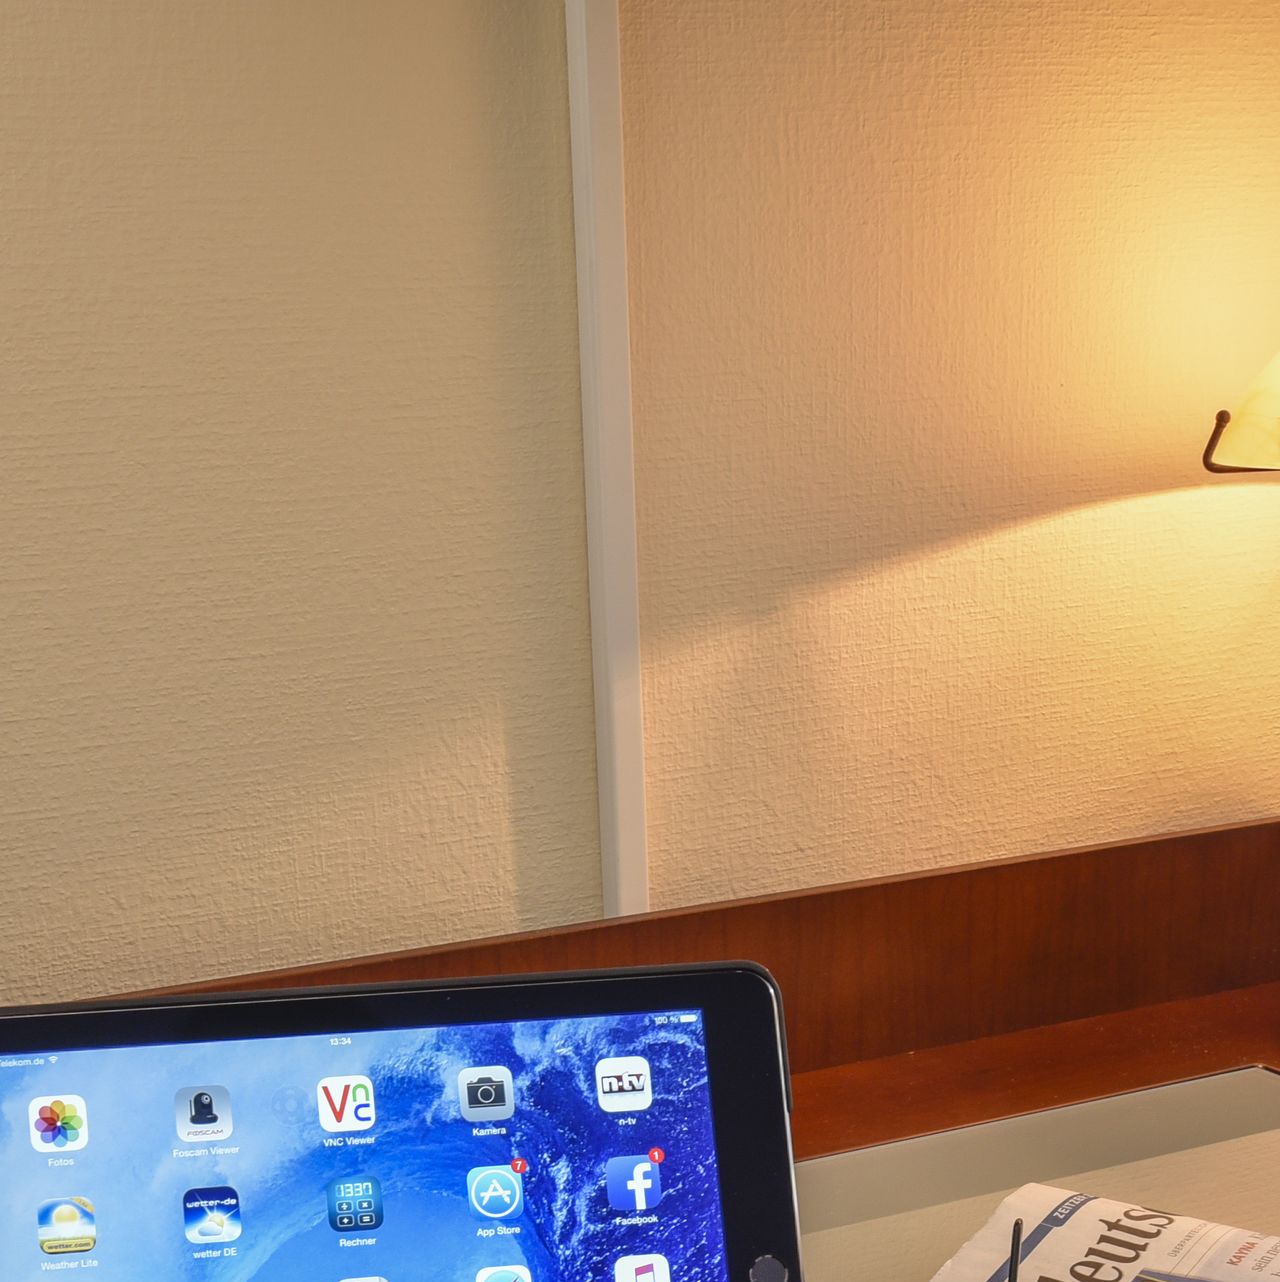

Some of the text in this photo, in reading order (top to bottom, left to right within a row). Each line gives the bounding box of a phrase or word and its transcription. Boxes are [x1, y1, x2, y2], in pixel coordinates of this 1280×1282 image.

[654, 1015, 668, 1024] 100
[329, 1036, 352, 1046] 13:34
[601, 1072, 646, 1094] n-tv
[619, 1116, 637, 1126] n-tv
[472, 1126, 507, 1137] Kamera
[323, 1135, 376, 1147] VNC Viewer
[172, 1145, 241, 1158] Foscam Viewer
[48, 1157, 75, 1167] Fotos
[336, 1182, 372, 1197] 1337
[616, 1215, 659, 1227] Facebook
[476, 1224, 521, 1238] App Store
[46, 1239, 92, 1251] wetter.com
[339, 1236, 377, 1248] Rechner
[193, 1247, 238, 1260] wetter DE
[1226, 1240, 1259, 1266] KAYNA
[40, 1257, 99, 1272] Weather Lite
[1252, 1255, 1271, 1273] sein
